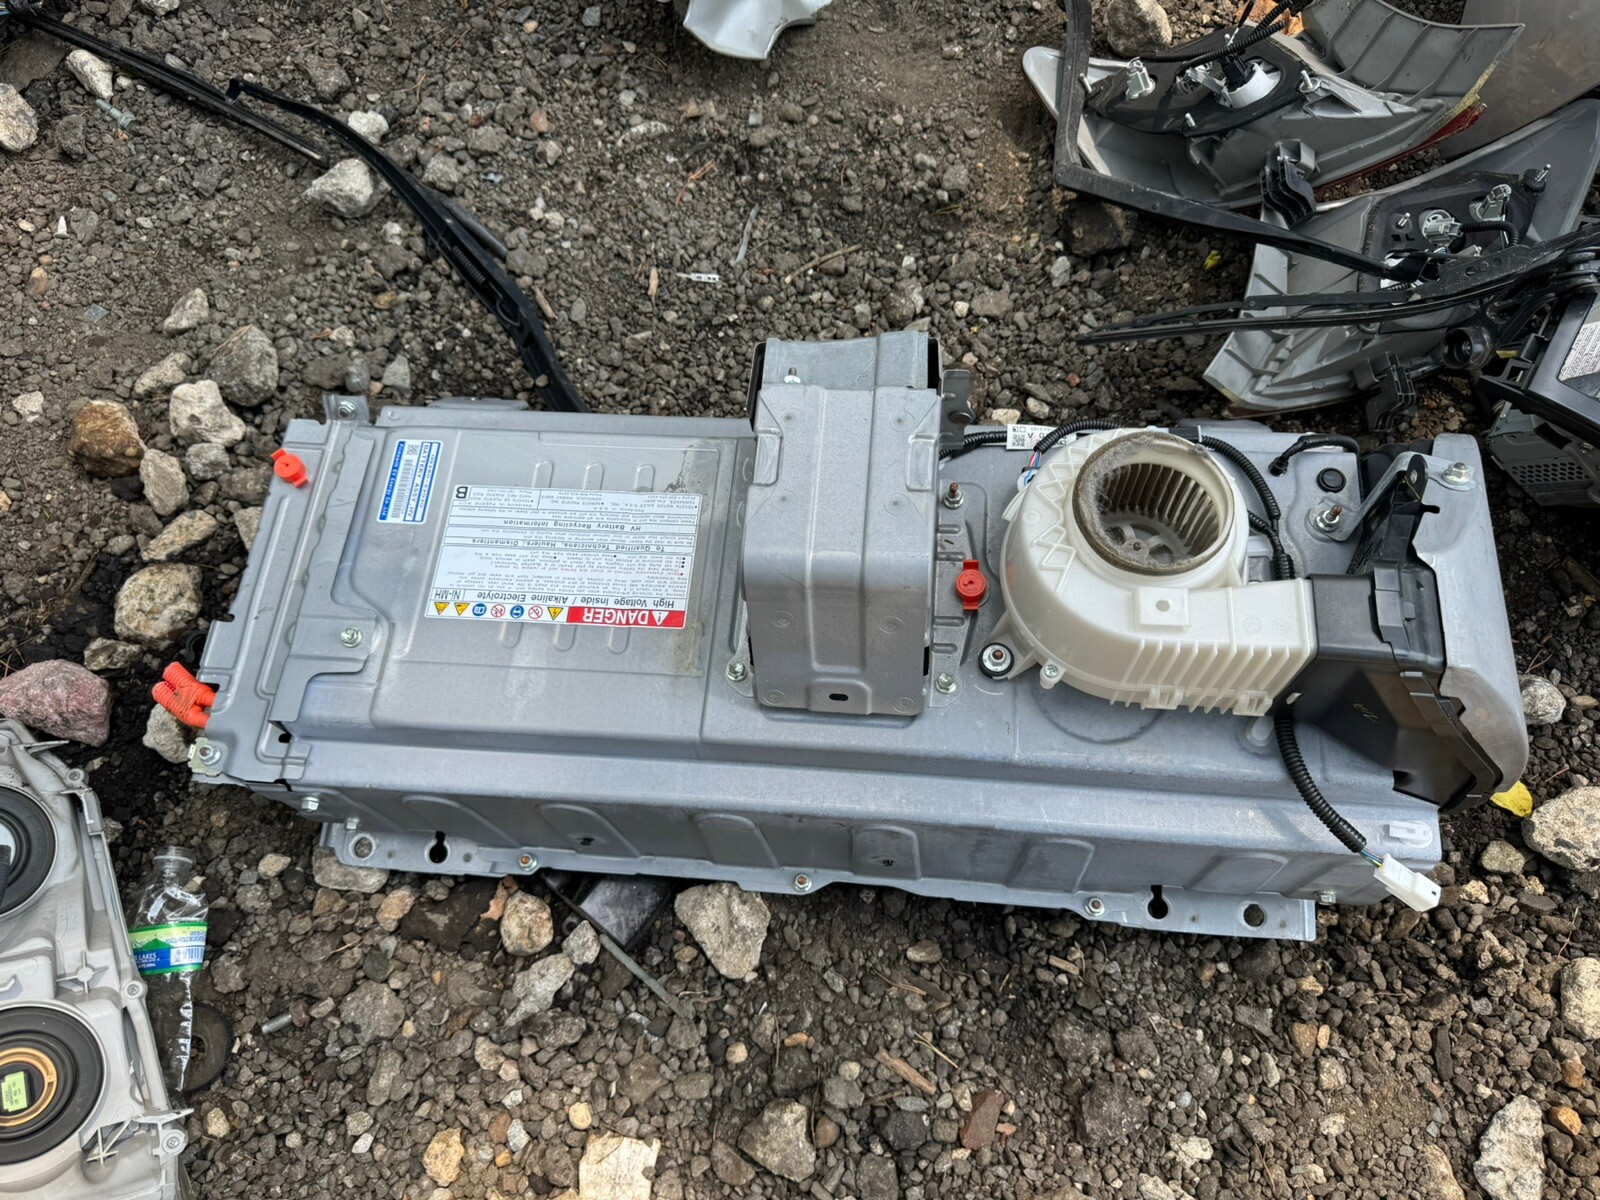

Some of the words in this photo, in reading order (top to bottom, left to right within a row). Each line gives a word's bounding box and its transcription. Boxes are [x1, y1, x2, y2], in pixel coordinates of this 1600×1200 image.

[416, 444, 428, 478] BATTERY
[454, 486, 468, 498] B
[433, 589, 460, 599] Ni-MH
[475, 590, 526, 602] Electrolyte
[530, 594, 568, 603] Alkaline
[580, 596, 609, 605] Inside
[613, 597, 647, 607] Voltage
[652, 597, 674, 608] High
[582, 607, 649, 624] DANGER
[139, 952, 157, 960] LAKES
